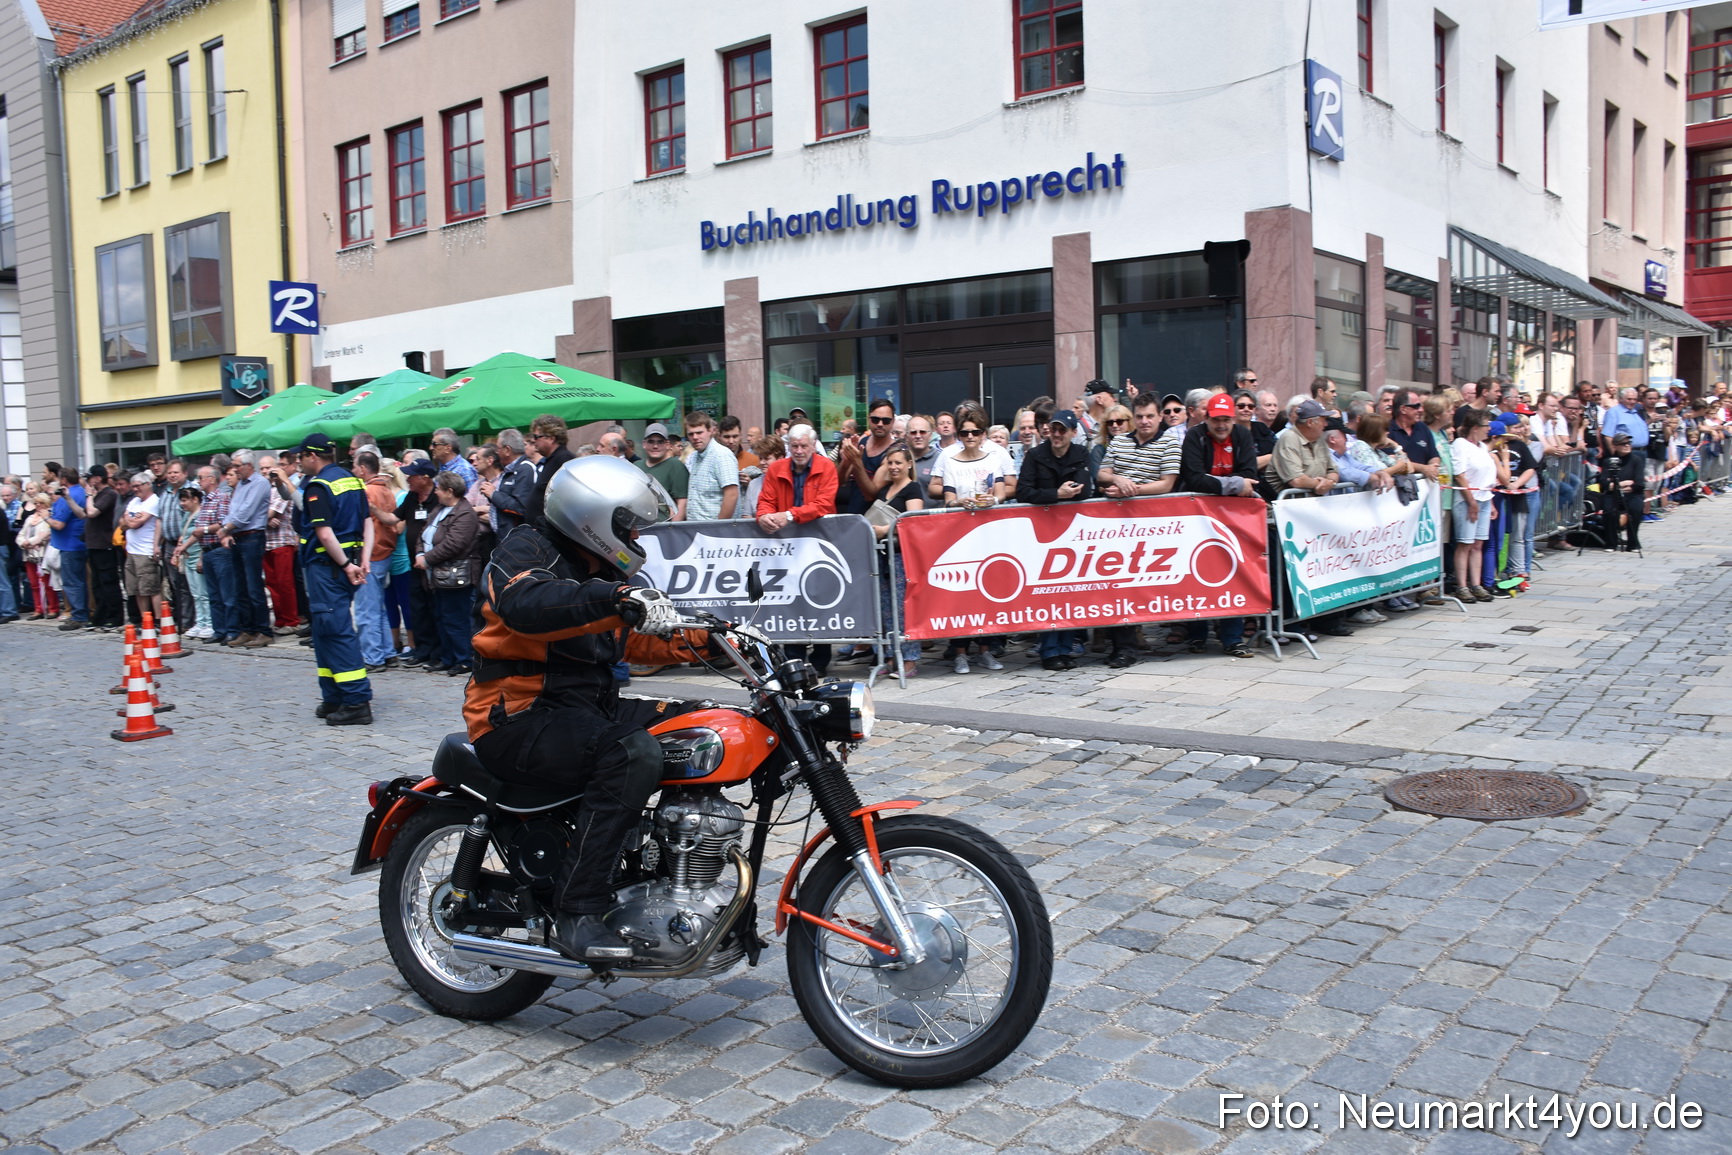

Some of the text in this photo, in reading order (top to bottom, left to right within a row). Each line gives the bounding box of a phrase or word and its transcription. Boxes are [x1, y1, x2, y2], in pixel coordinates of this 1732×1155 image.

[700, 151, 1125, 251] Buchhandlung Rupprecht
[342, 345, 356, 356] Markt
[582, 525, 614, 555] DUCATI
[1072, 520, 1185, 542] Autoklassik
[693, 542, 796, 560] Autoklassik
[1038, 541, 1179, 581] Dietz
[1031, 582, 1111, 595] BREITENBRUNN
[930, 591, 1246, 631] www.autoklassik-dietz.de
